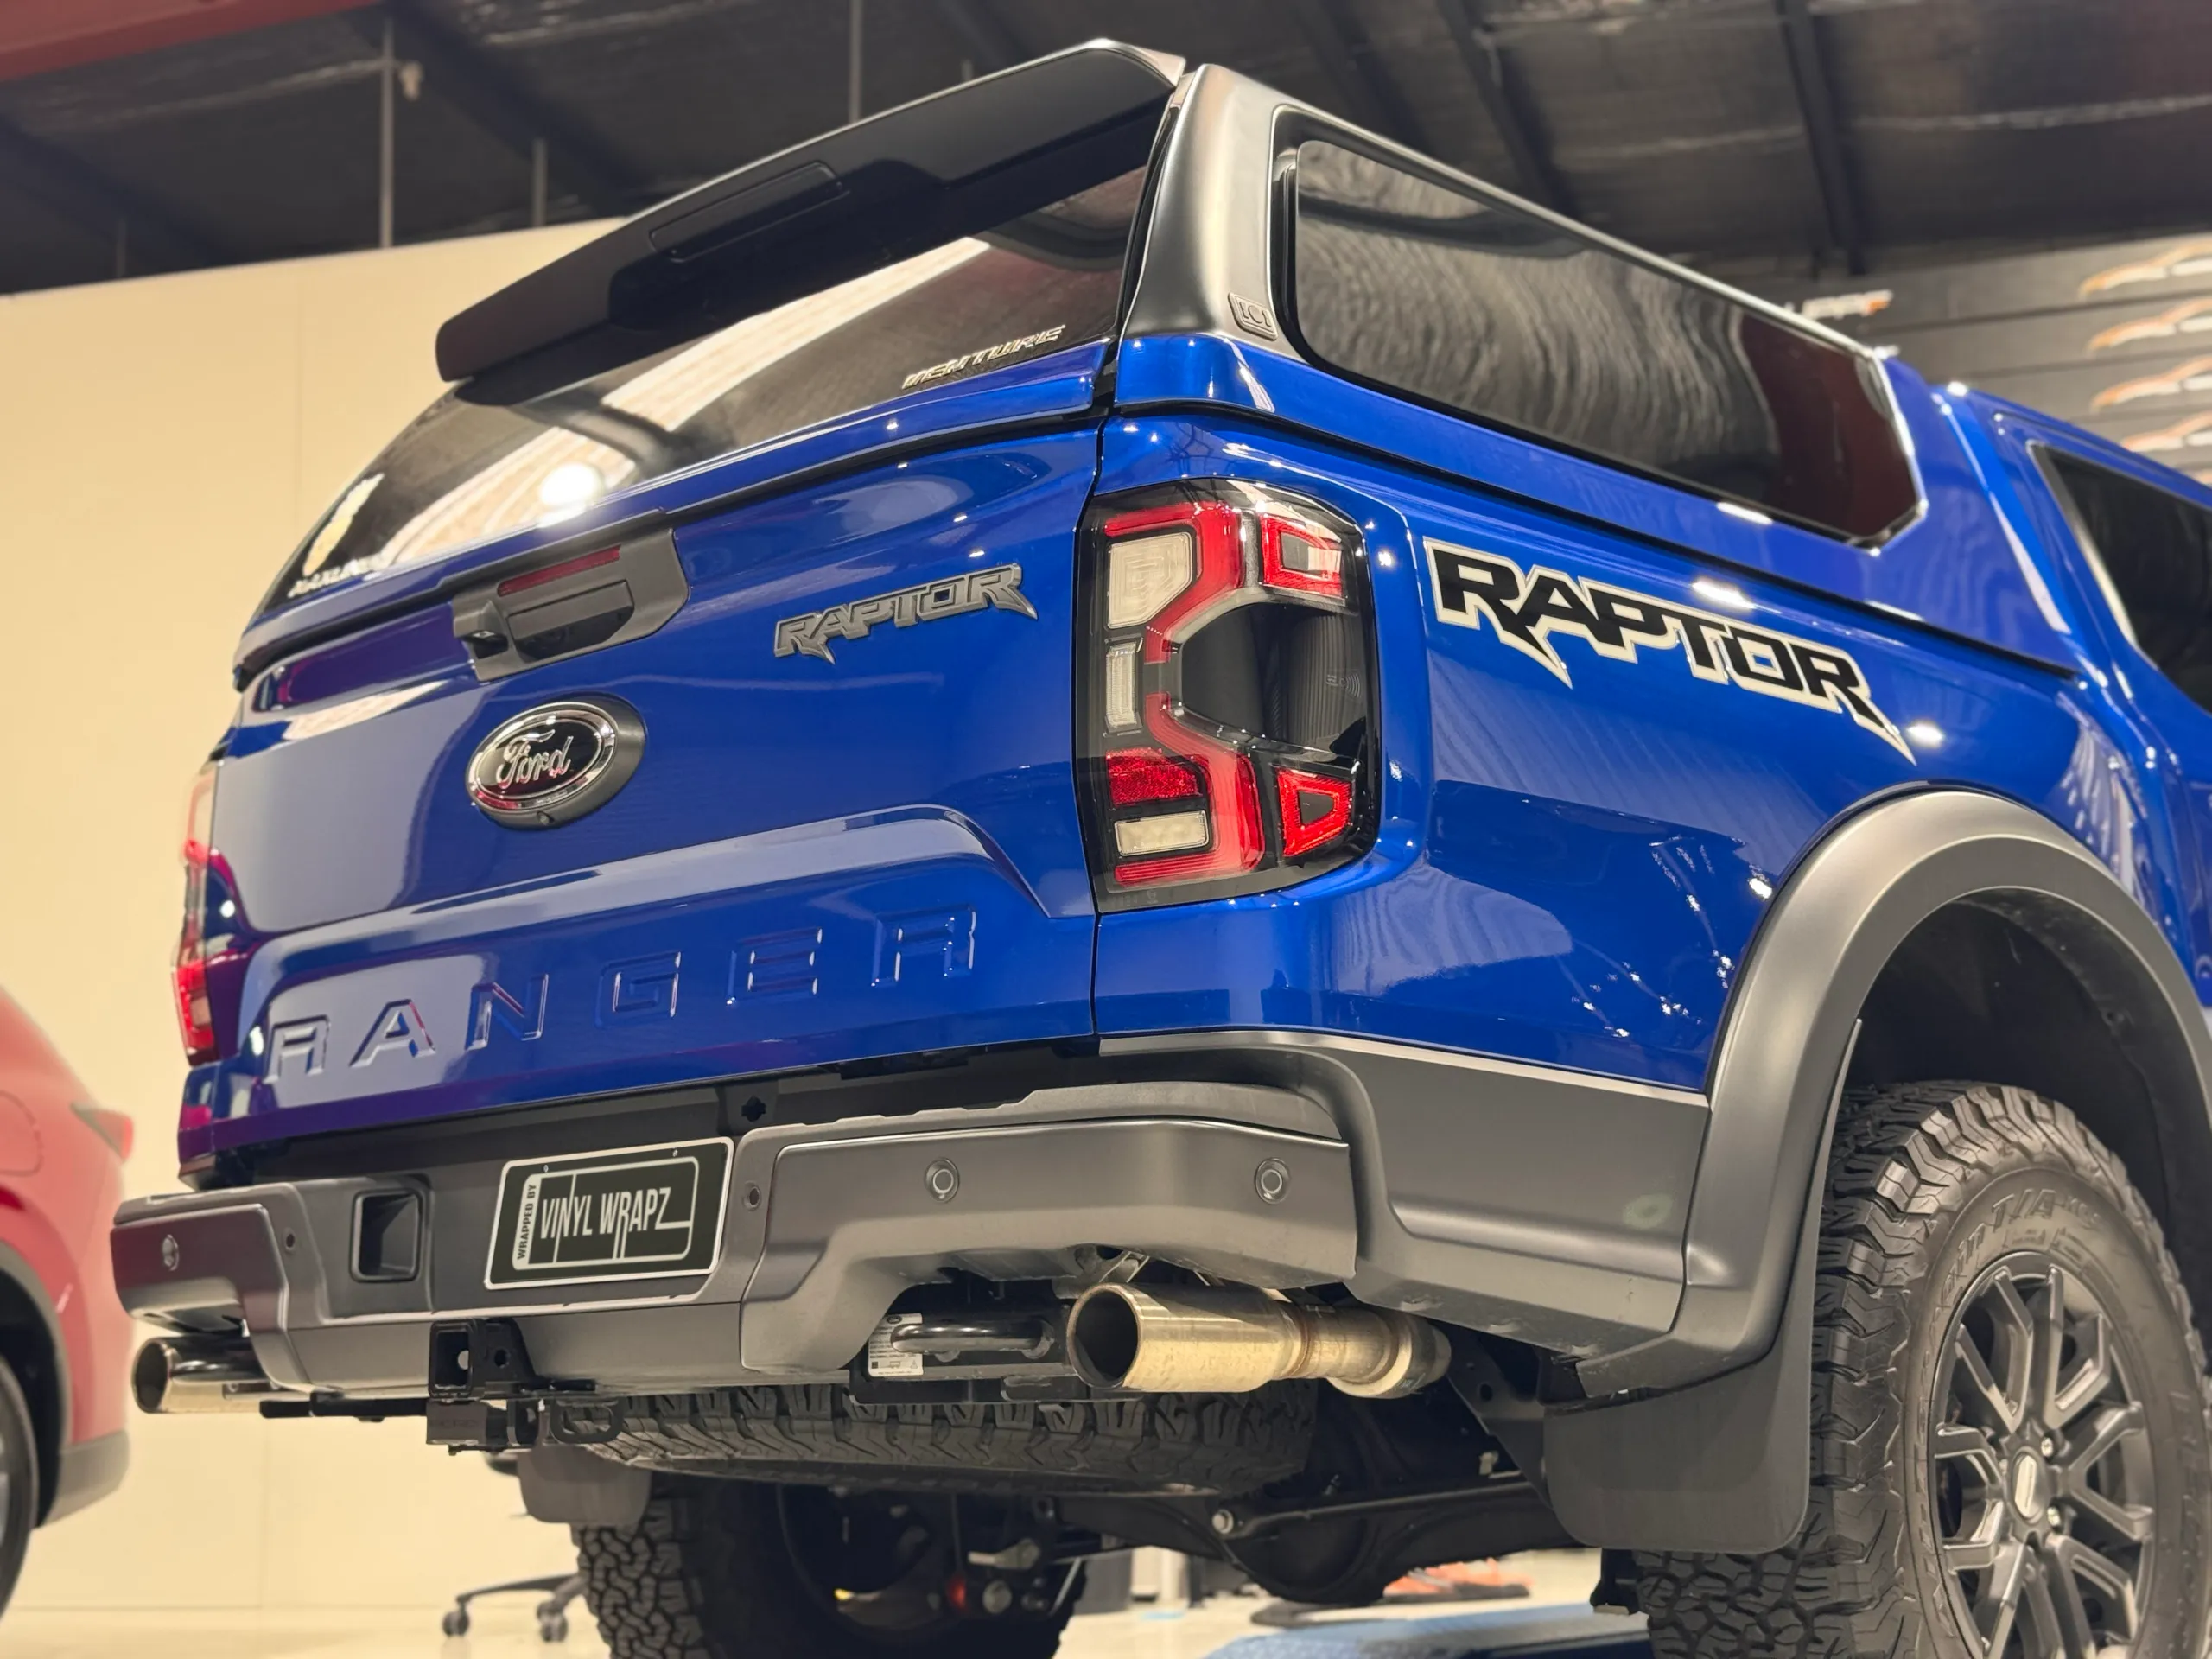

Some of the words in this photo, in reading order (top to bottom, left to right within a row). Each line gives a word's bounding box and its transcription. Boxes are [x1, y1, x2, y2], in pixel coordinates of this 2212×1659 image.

[902, 324, 1066, 389] VENTURE
[773, 563, 1039, 665] RAPTOR
[1422, 536, 1917, 766] RAPTOR
[496, 729, 575, 790] Ford
[264, 905, 977, 1084] RANGER
[517, 1202, 534, 1261] WRAPPED
[526, 1184, 537, 1199] BY
[540, 1190, 593, 1244] VINYL
[599, 1186, 674, 1241] WRAPZ
